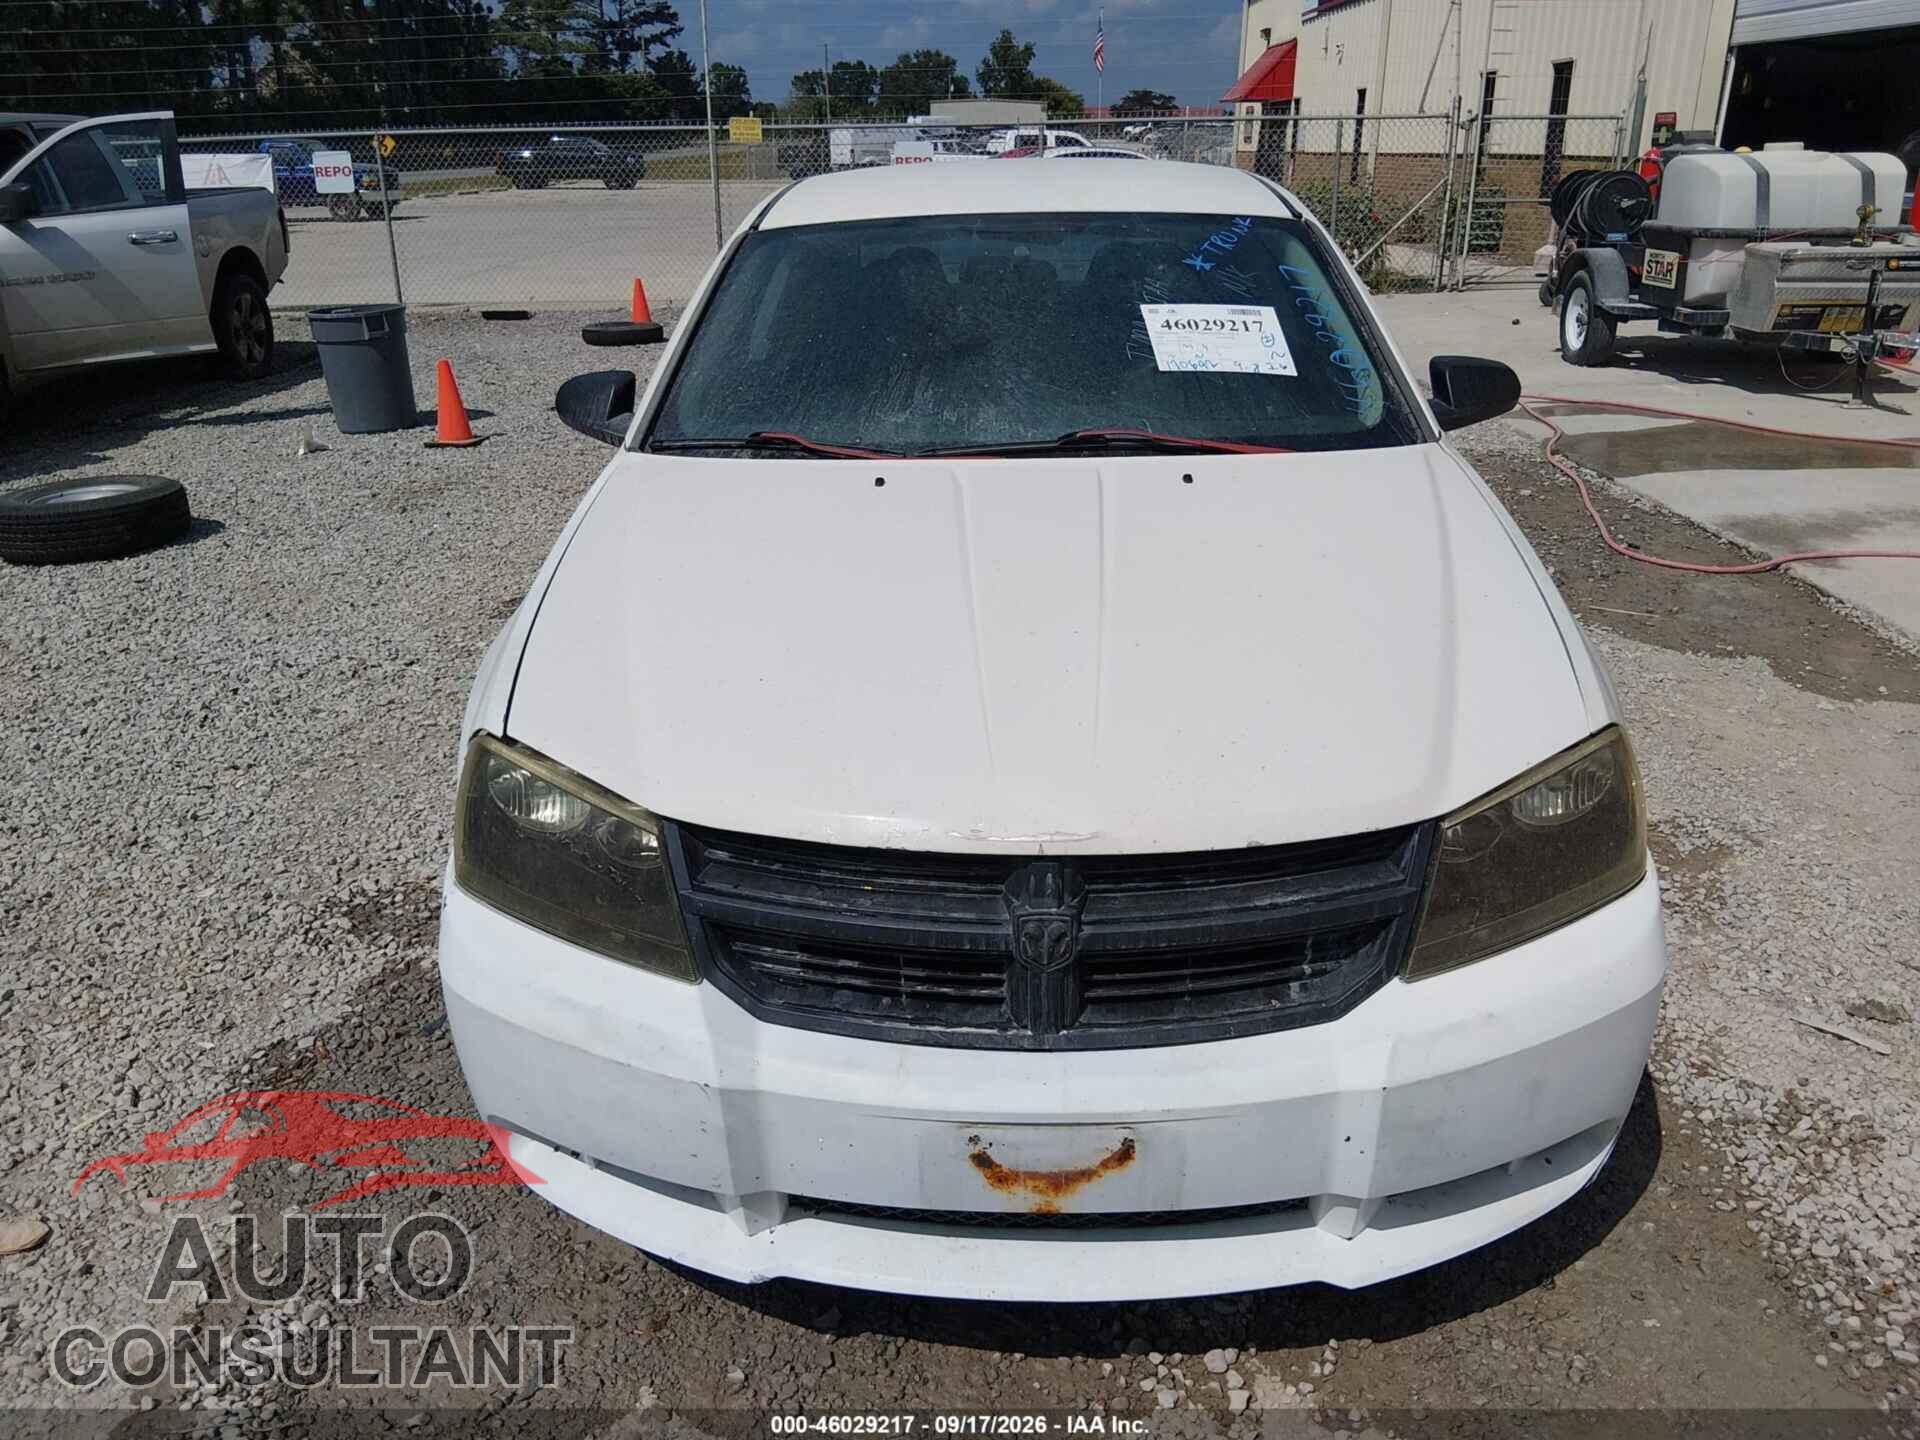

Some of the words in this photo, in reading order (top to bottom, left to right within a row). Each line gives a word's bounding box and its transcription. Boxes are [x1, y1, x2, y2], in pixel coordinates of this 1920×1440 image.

[315, 165, 352, 178] REPO
[1646, 258, 1674, 278] STAR
[1160, 318, 1263, 333] 46029217
